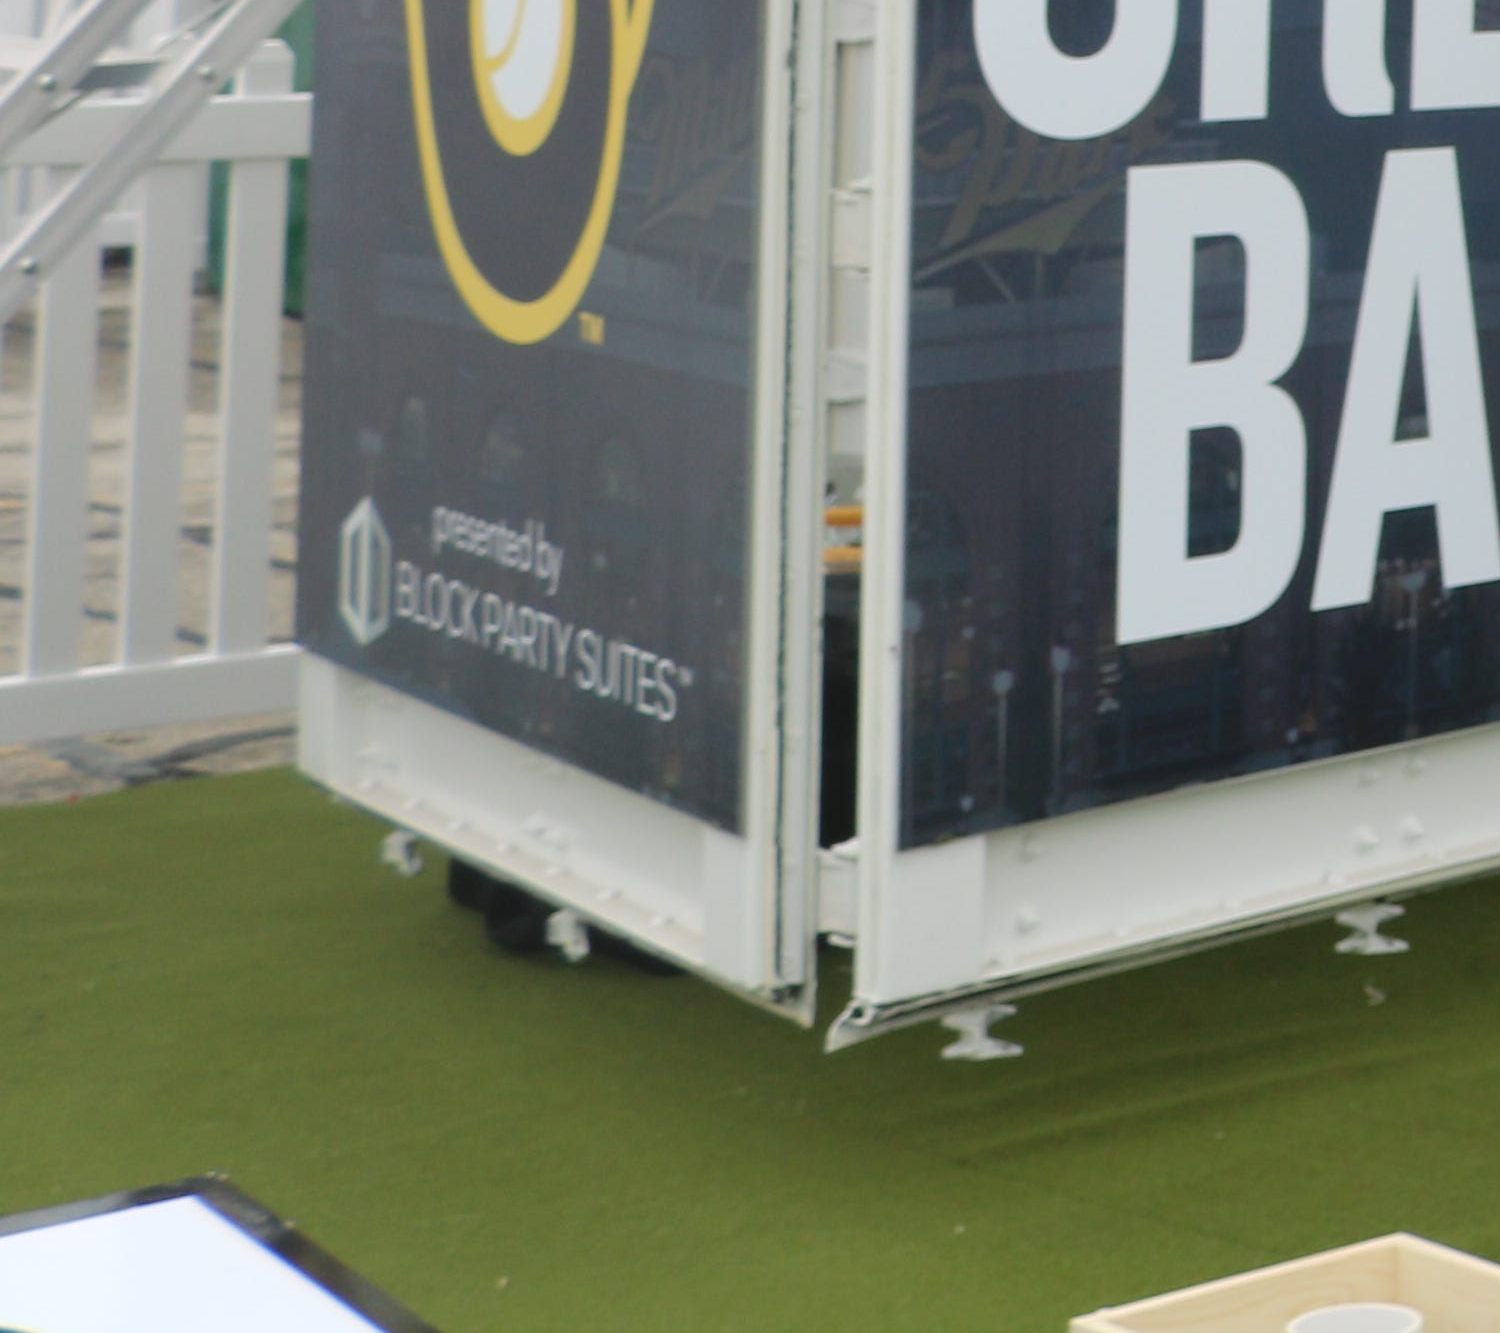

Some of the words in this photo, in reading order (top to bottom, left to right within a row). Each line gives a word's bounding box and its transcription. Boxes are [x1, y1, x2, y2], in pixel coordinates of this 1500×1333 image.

[432, 505, 535, 573] presented
[534, 520, 565, 597] by
[395, 559, 481, 646] BLOCK
[481, 591, 575, 680] PARTY
